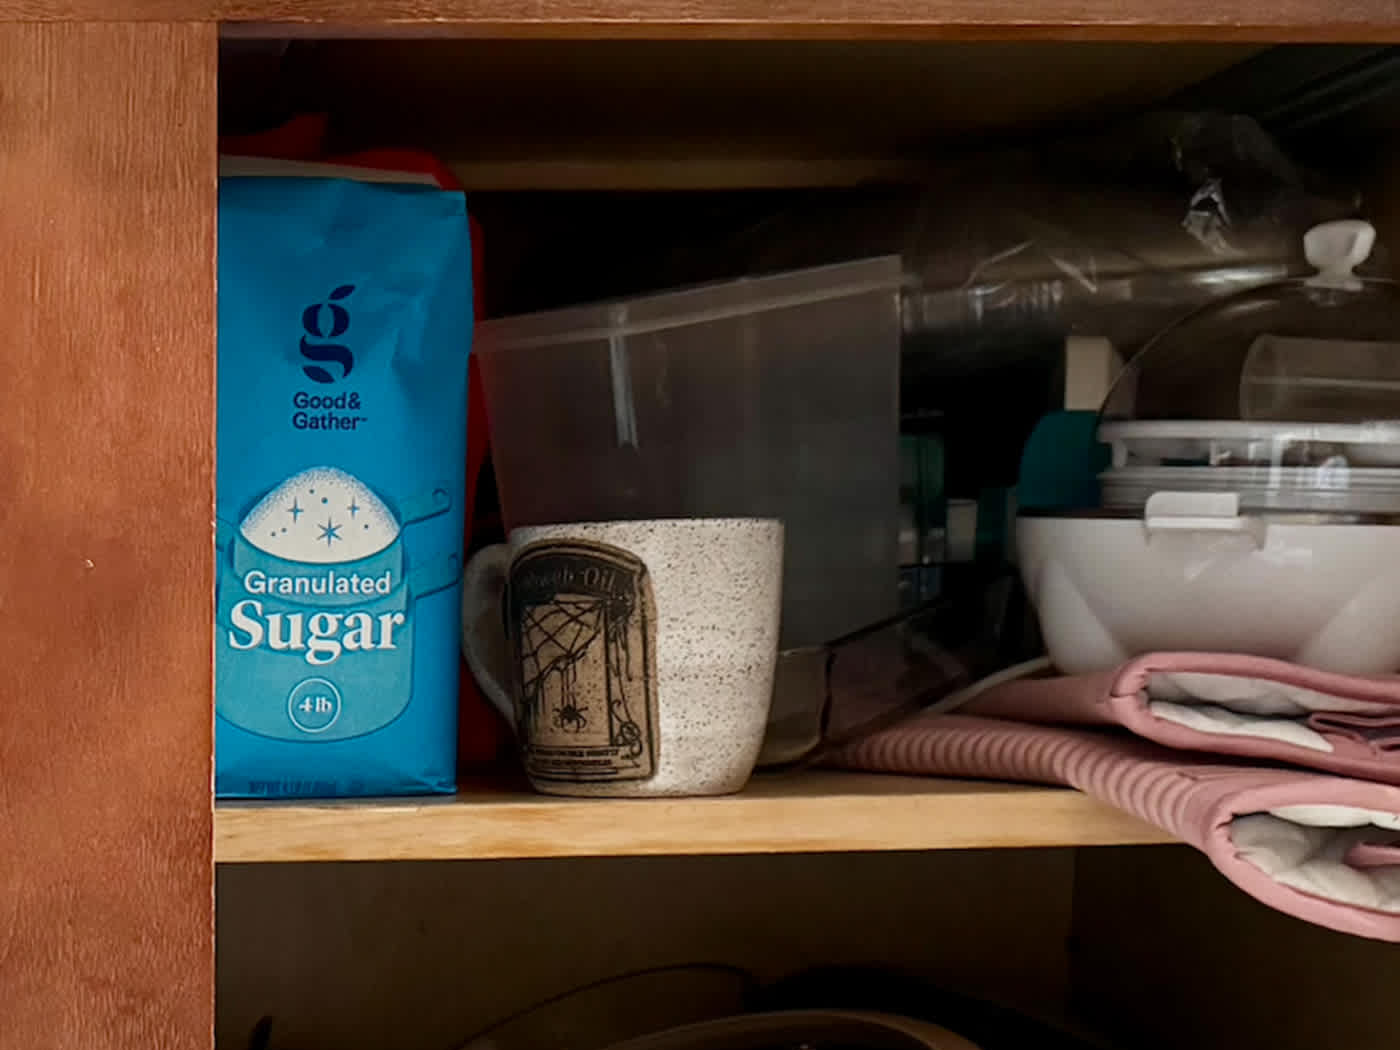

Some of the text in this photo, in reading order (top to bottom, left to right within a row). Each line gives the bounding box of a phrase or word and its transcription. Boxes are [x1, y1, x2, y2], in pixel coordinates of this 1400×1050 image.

[244, 570, 392, 595] Granulated
[228, 599, 406, 665] Sugar
[299, 696, 333, 713] 4 lb
